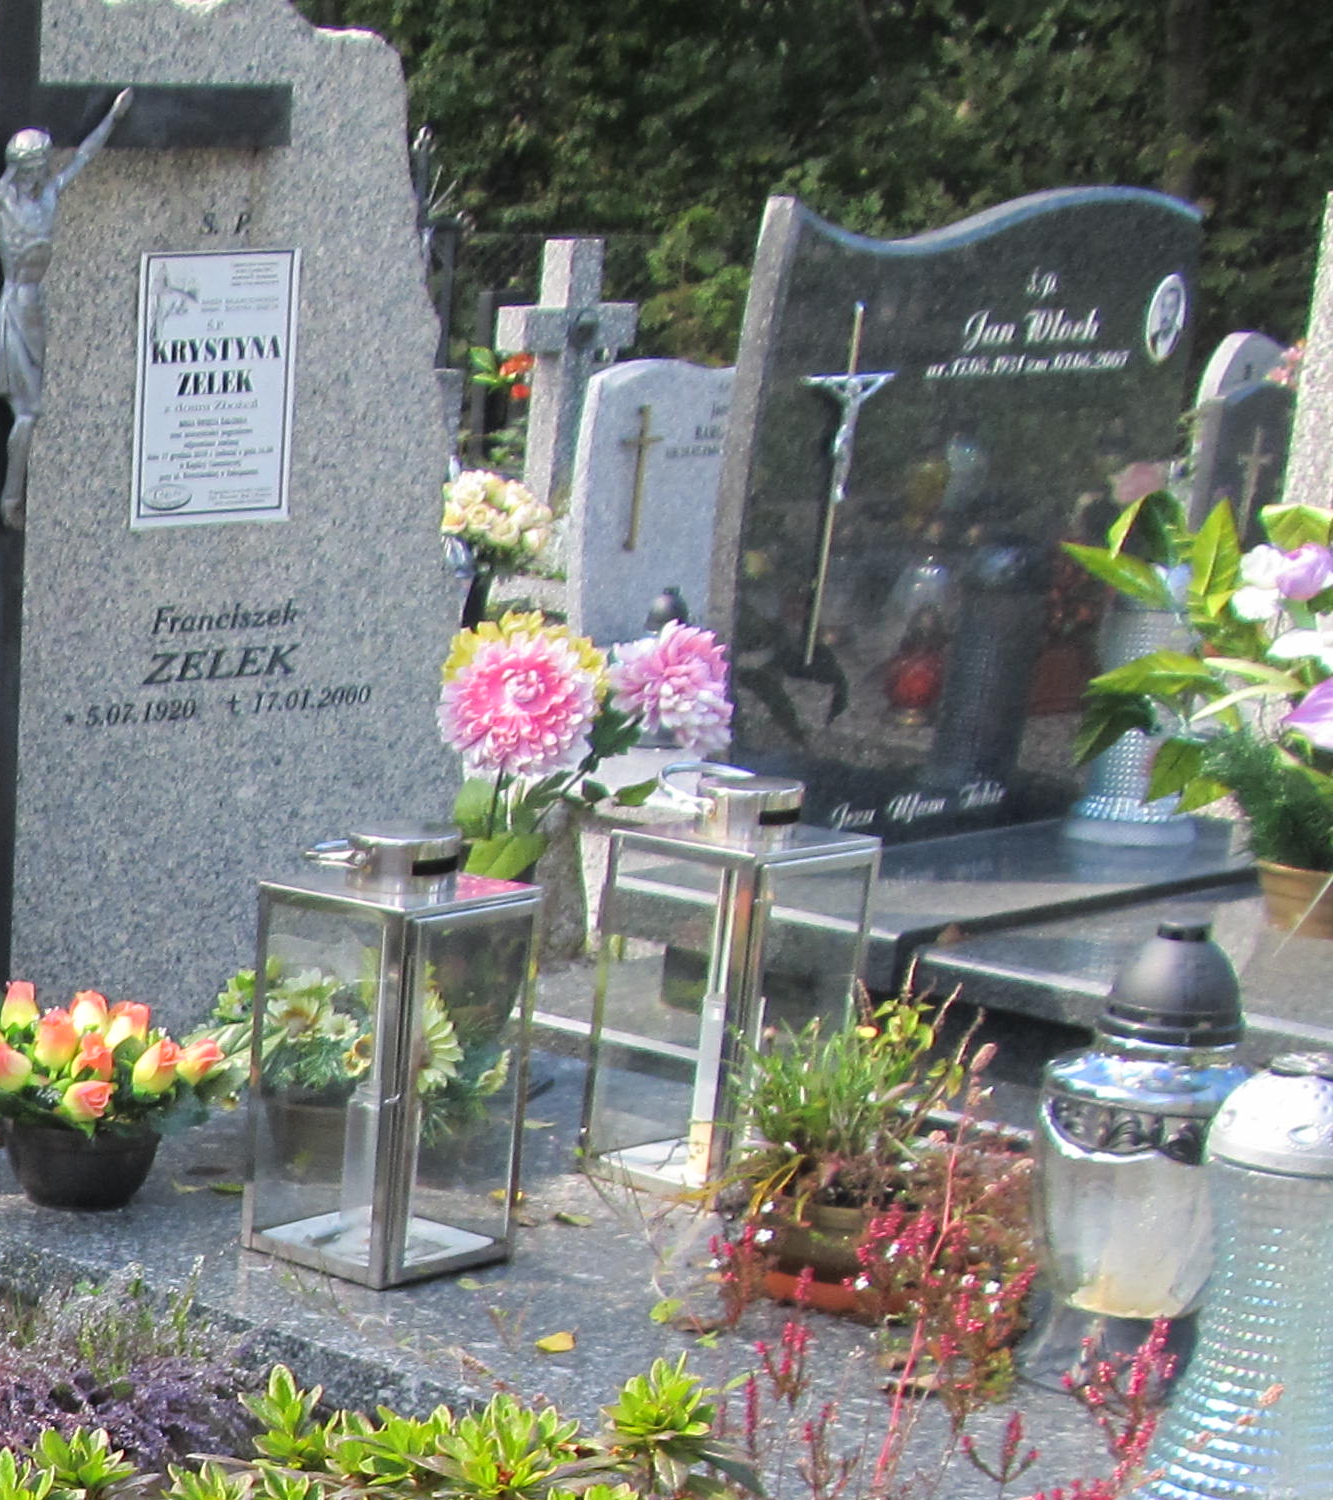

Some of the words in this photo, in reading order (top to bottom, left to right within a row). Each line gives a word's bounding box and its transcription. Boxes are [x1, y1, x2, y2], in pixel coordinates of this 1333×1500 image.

[963, 308, 1017, 351] Jan
[152, 335, 281, 364] KRYSTYNA
[177, 369, 253, 396] ZELEK
[152, 599, 298, 635] Franciszek
[142, 644, 300, 685] ZELEK
[254, 684, 371, 714] 17.01.2000
